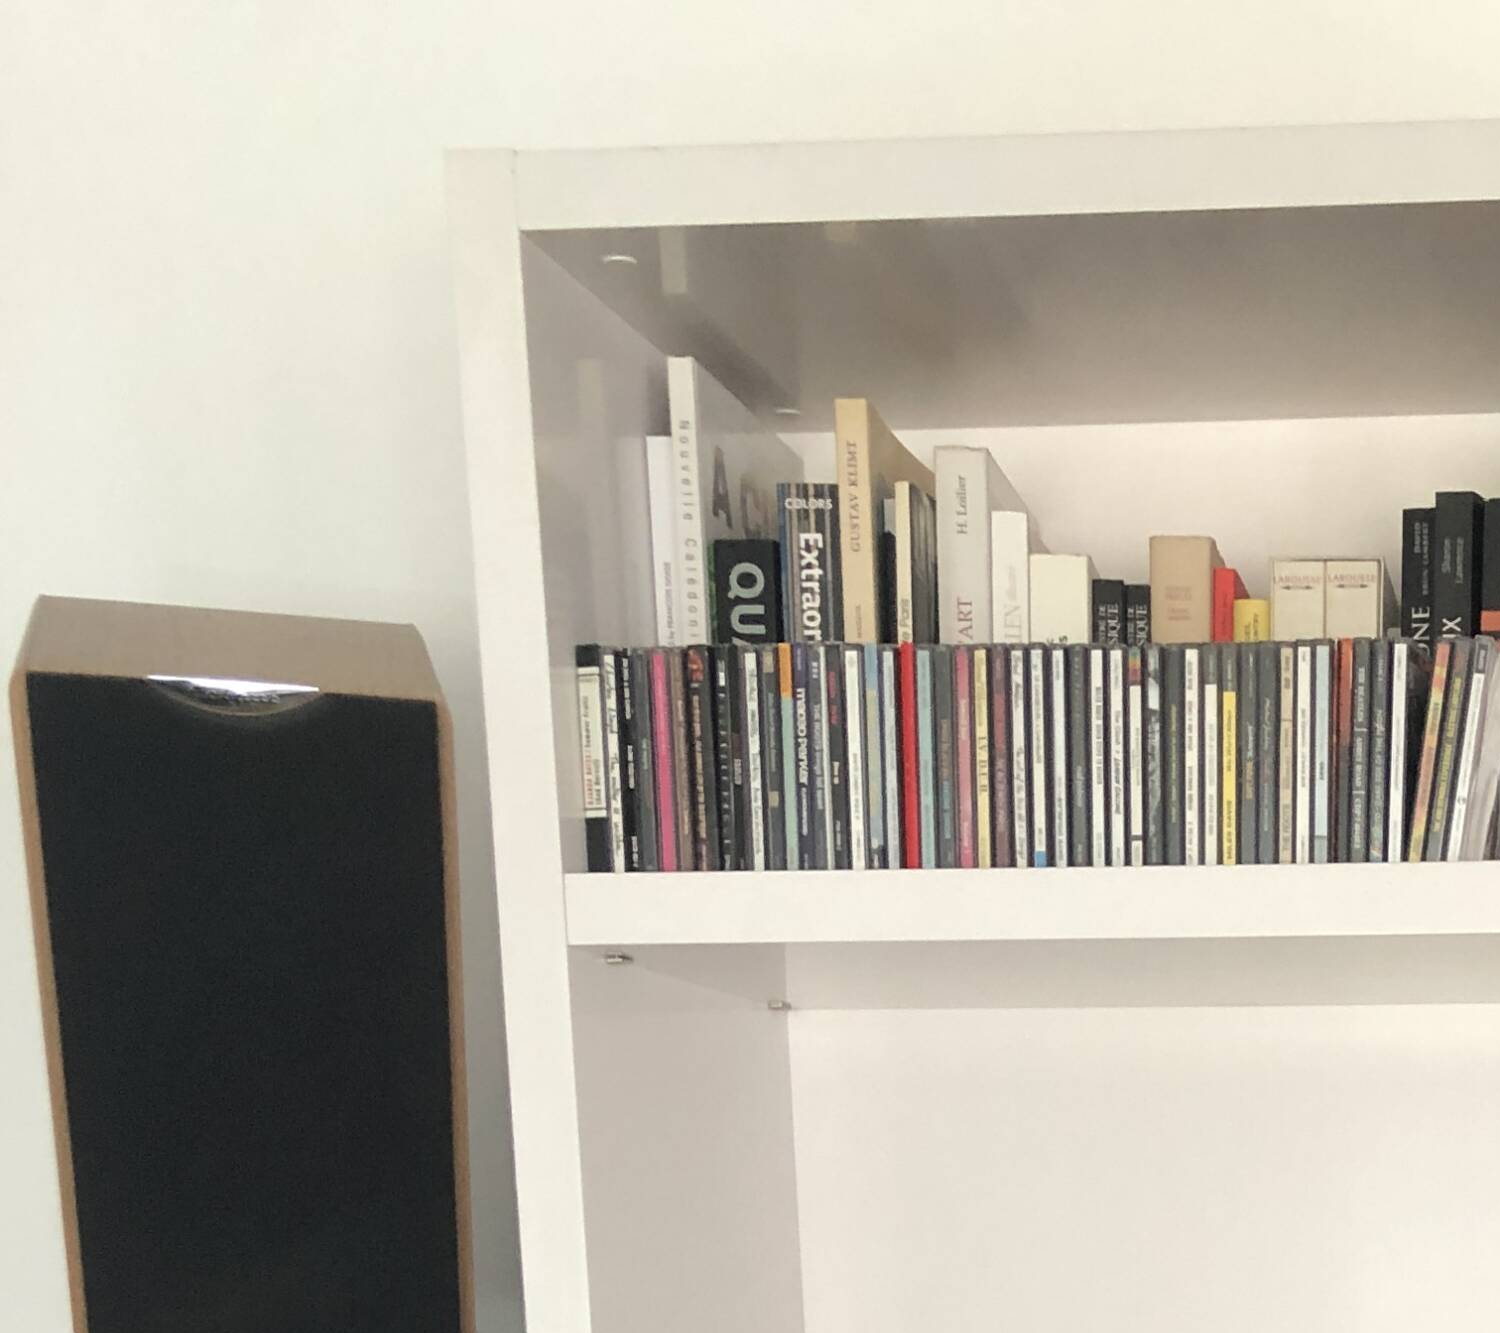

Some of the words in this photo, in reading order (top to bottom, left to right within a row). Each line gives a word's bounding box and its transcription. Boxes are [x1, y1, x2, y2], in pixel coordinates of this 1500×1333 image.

[680, 420, 694, 521] Nouvelle
[846, 438, 858, 488] KLIMT
[784, 498, 833, 510] COLORS
[848, 493, 862, 553] GUSTAV
[798, 532, 824, 643] Extraor
